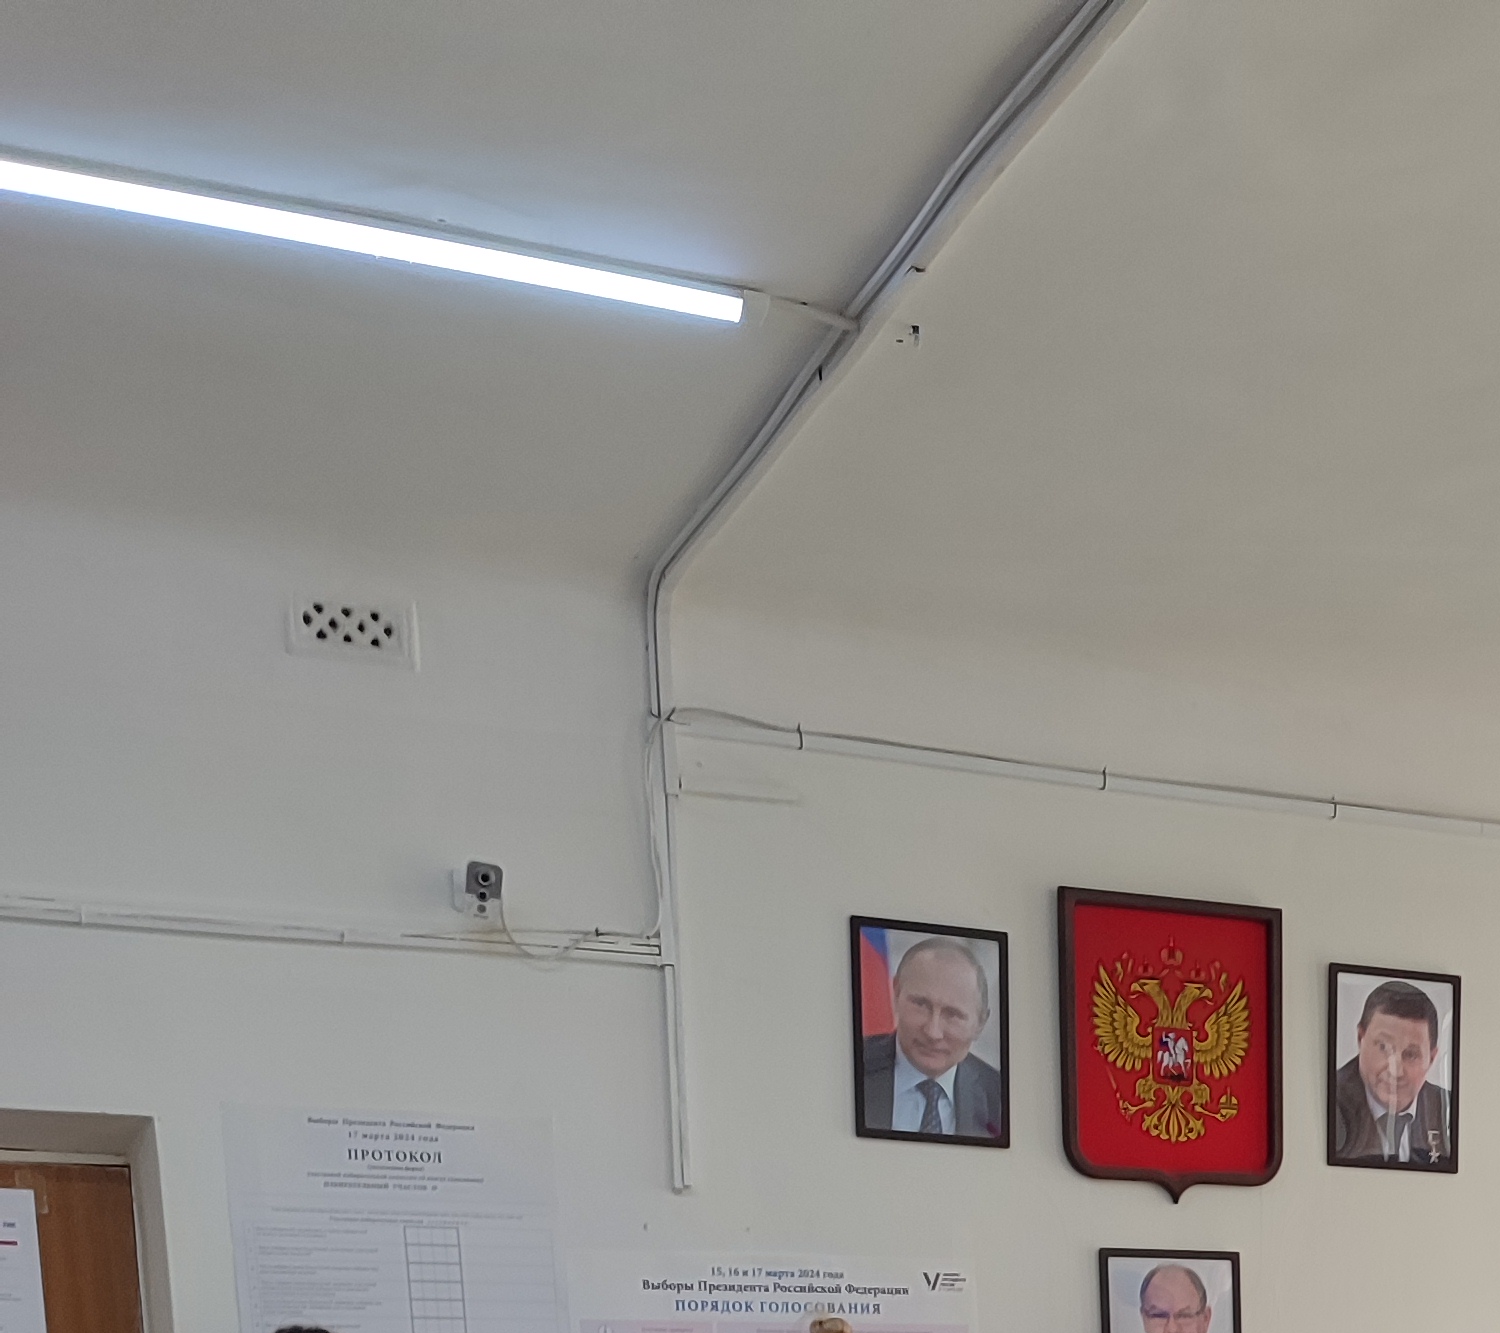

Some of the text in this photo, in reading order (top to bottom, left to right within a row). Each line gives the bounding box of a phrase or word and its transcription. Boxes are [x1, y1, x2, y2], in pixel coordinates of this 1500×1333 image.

[347, 1148, 443, 1164] ПРОТОКОЛ
[711, 1266, 725, 1278] 15,
[728, 1267, 739, 1277] 16
[742, 1269, 749, 1277] и
[752, 1267, 763, 1277] 17
[765, 1269, 795, 1280] марта
[797, 1269, 820, 1278] 2024
[642, 1279, 909, 1298] Выборы Президента Российской Федерации
[675, 1299, 881, 1315] ПОРЯДОК ГОЛОСОВАНИЯ
